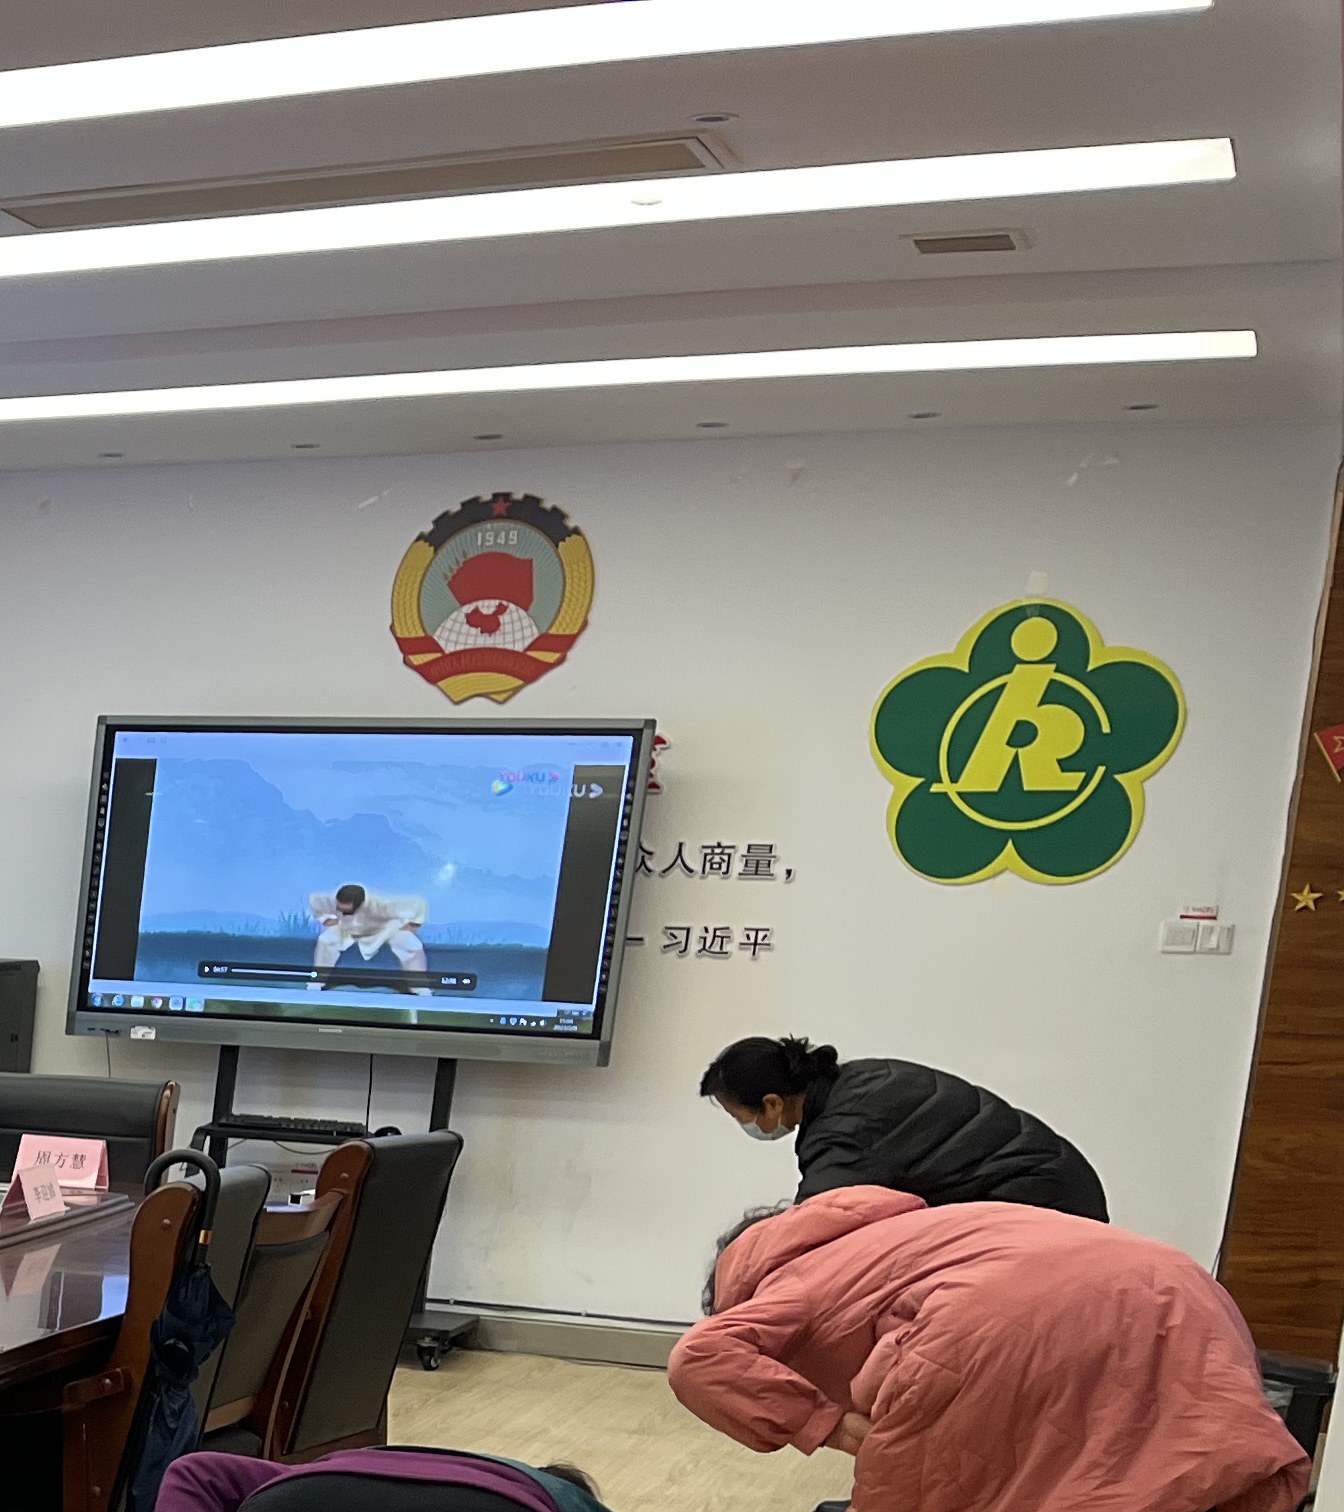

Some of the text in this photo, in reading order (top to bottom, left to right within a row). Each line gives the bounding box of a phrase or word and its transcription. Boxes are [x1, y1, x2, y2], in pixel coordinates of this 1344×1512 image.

[476, 530, 518, 546] 1949
[35, 1150, 87, 1170] 周方慧
